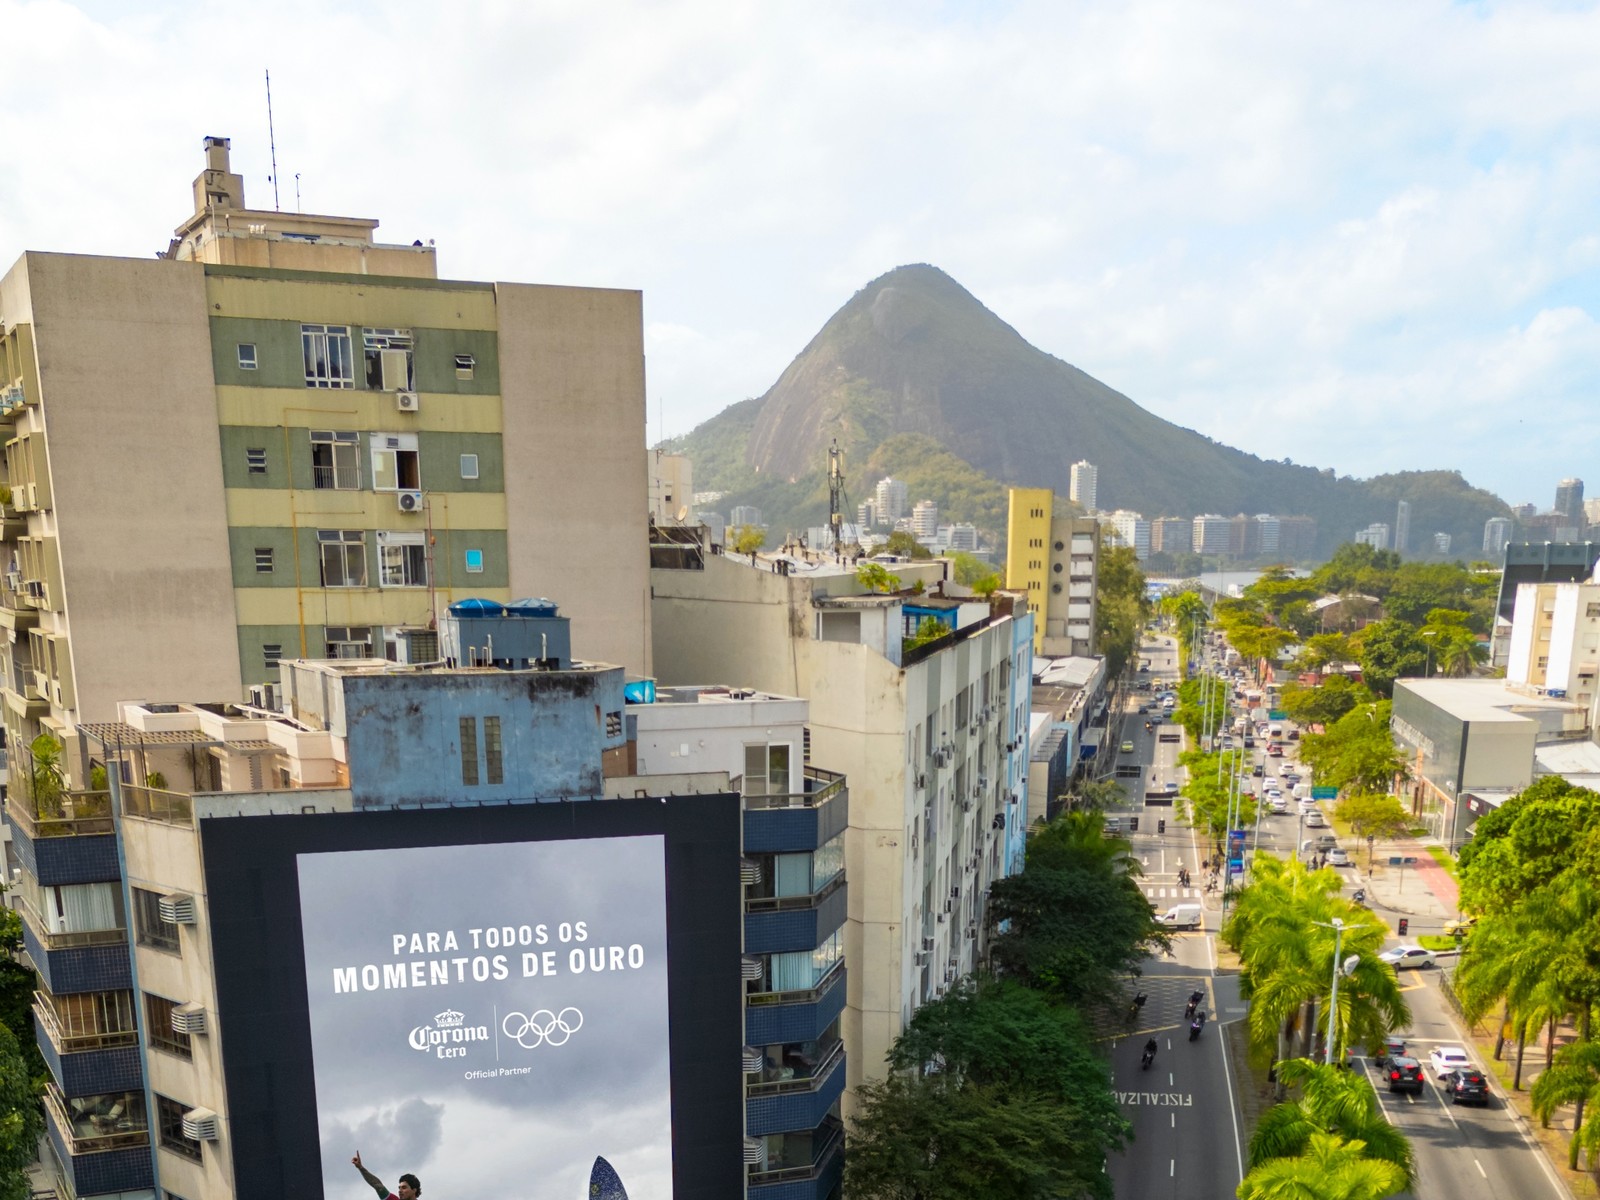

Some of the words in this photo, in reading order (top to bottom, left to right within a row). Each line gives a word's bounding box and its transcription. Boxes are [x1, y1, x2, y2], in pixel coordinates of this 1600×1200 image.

[392, 930, 459, 955] PARA
[469, 924, 549, 949] TODOS
[558, 921, 588, 943] OS
[333, 955, 509, 994] MOMENTOS
[522, 951, 557, 978] DE
[569, 944, 645, 974] OURO
[408, 1025, 489, 1053] Corona
[437, 1045, 467, 1060] Cero
[464, 1068, 498, 1080] Official
[499, 1066, 532, 1076] Partner
